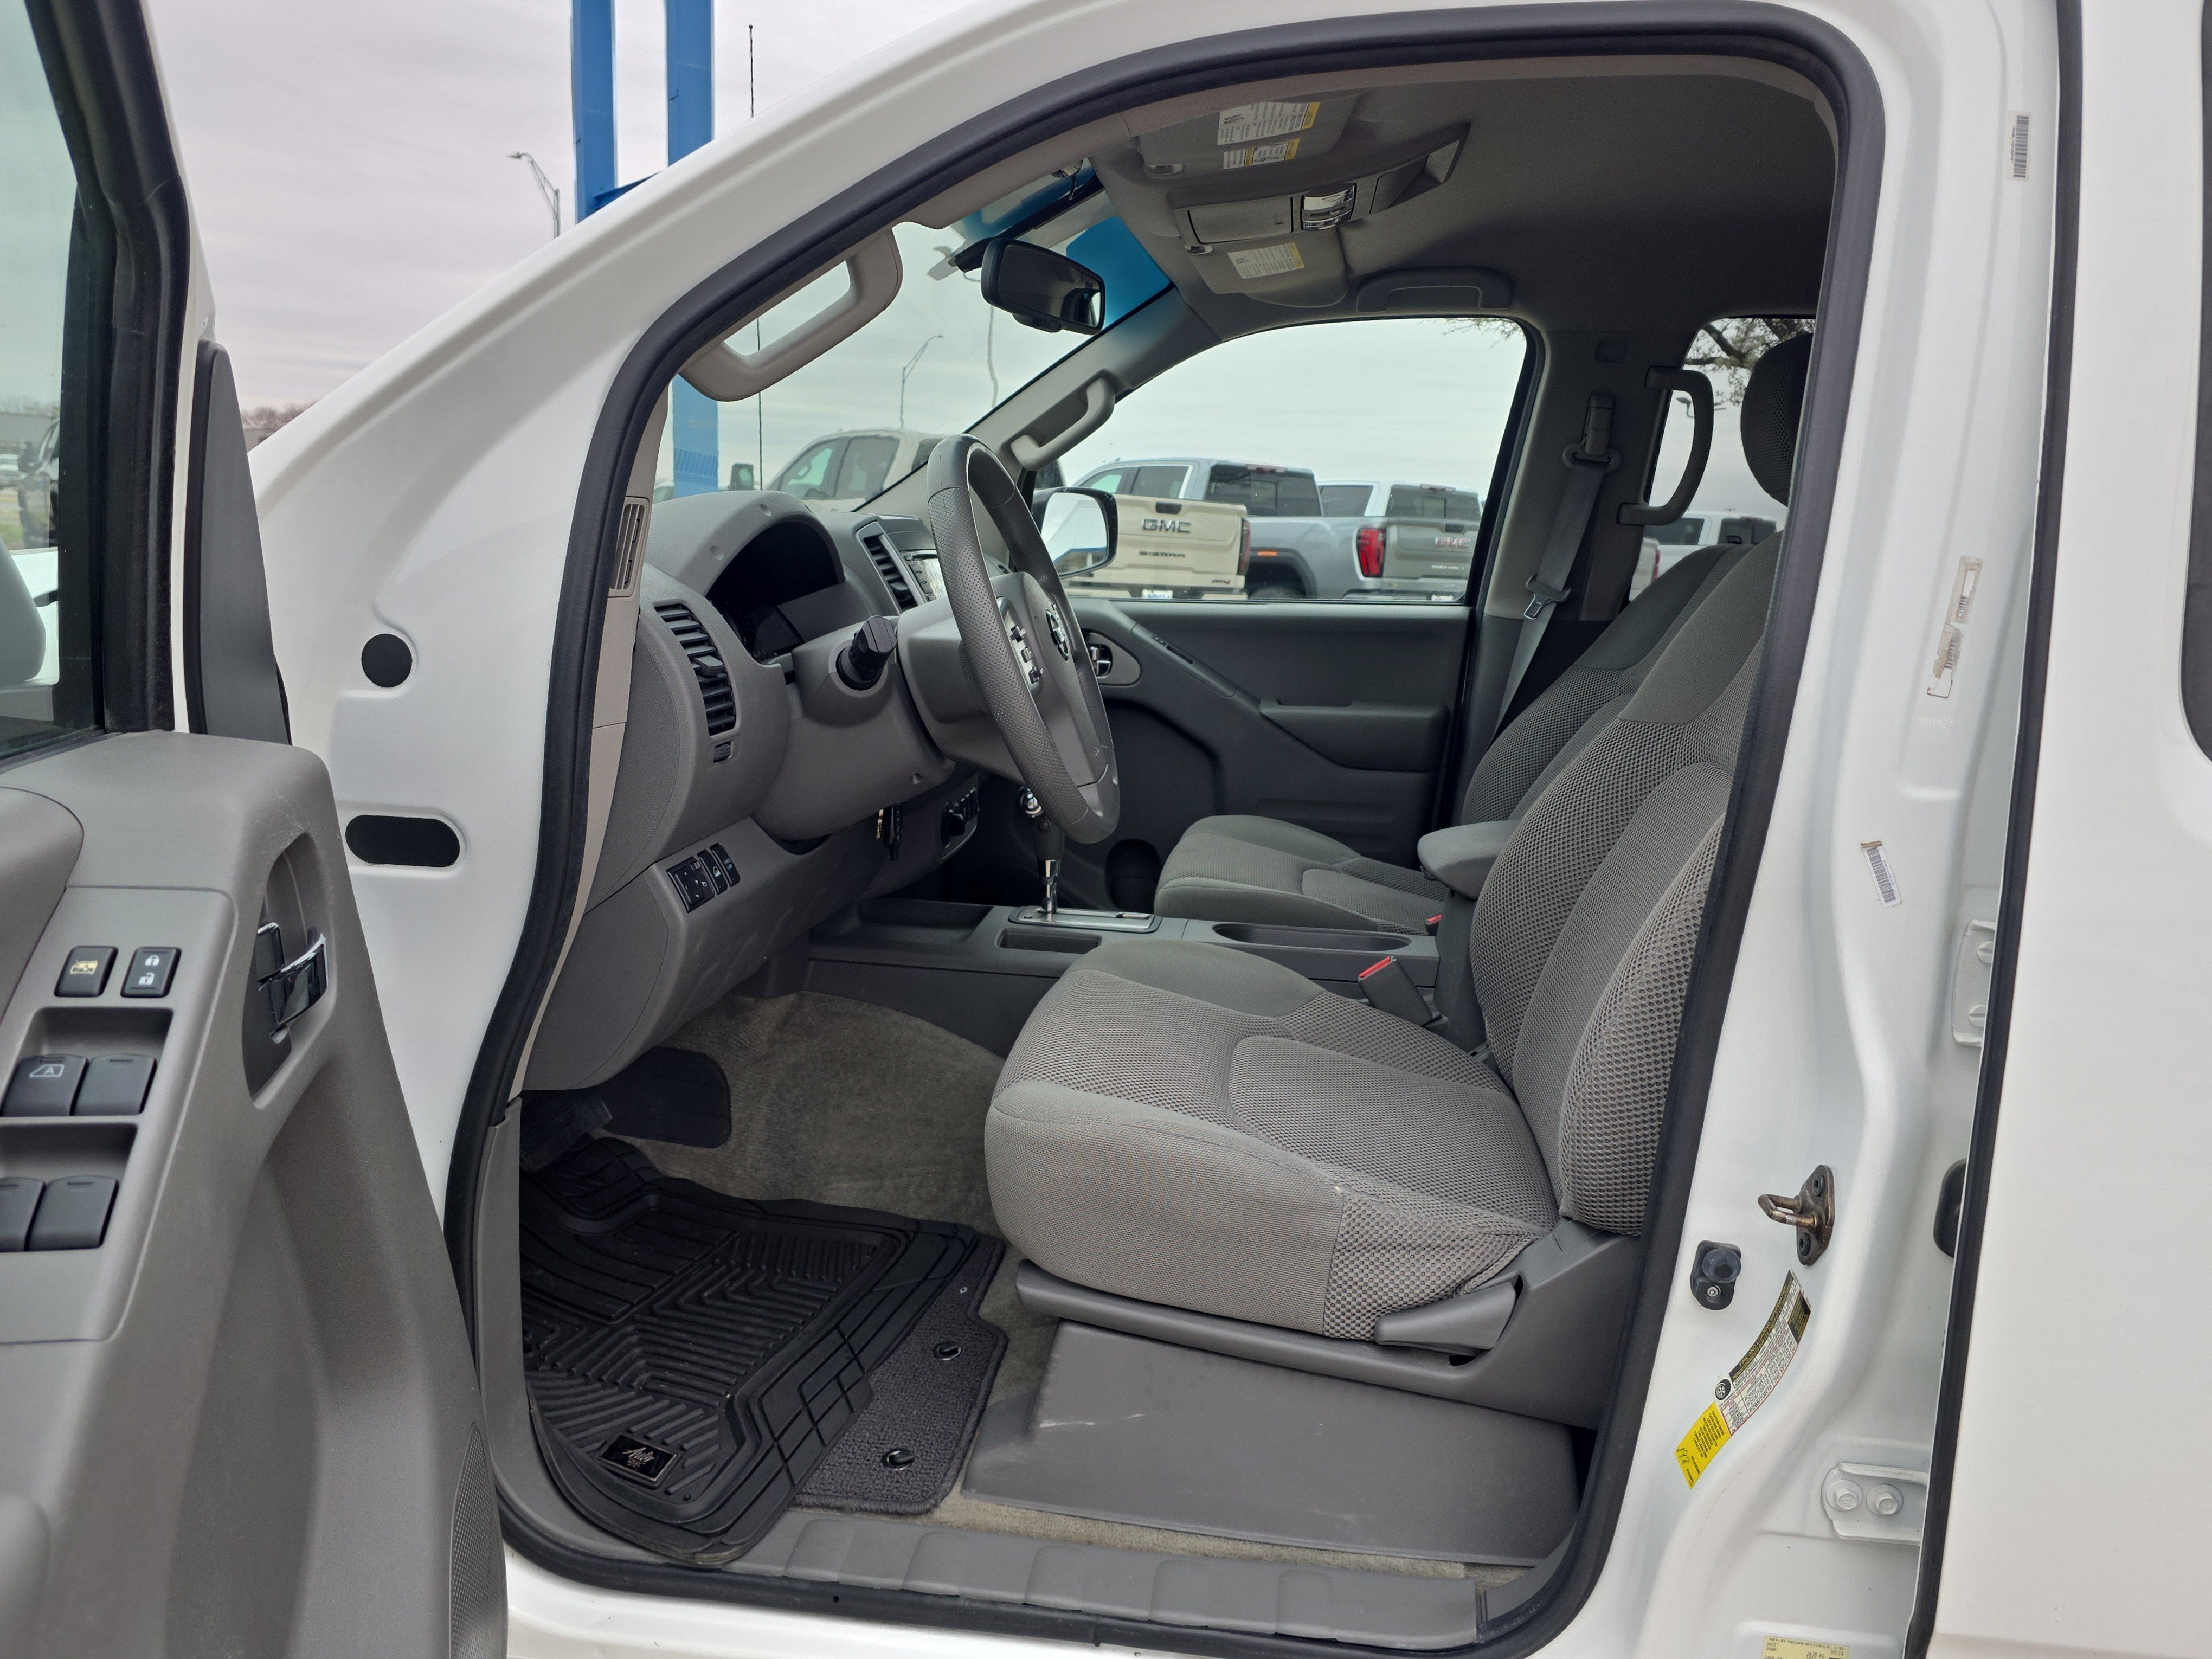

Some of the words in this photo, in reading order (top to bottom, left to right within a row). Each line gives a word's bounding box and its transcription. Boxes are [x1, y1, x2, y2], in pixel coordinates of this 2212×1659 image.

[1142, 518, 1192, 533] GMC
[1435, 536, 1471, 549] GMC
[1744, 1373, 1767, 1402] P265/70R16
[1746, 1379, 1770, 1408] P265/70R16
[1748, 1385, 1772, 1413] P265/70R16
